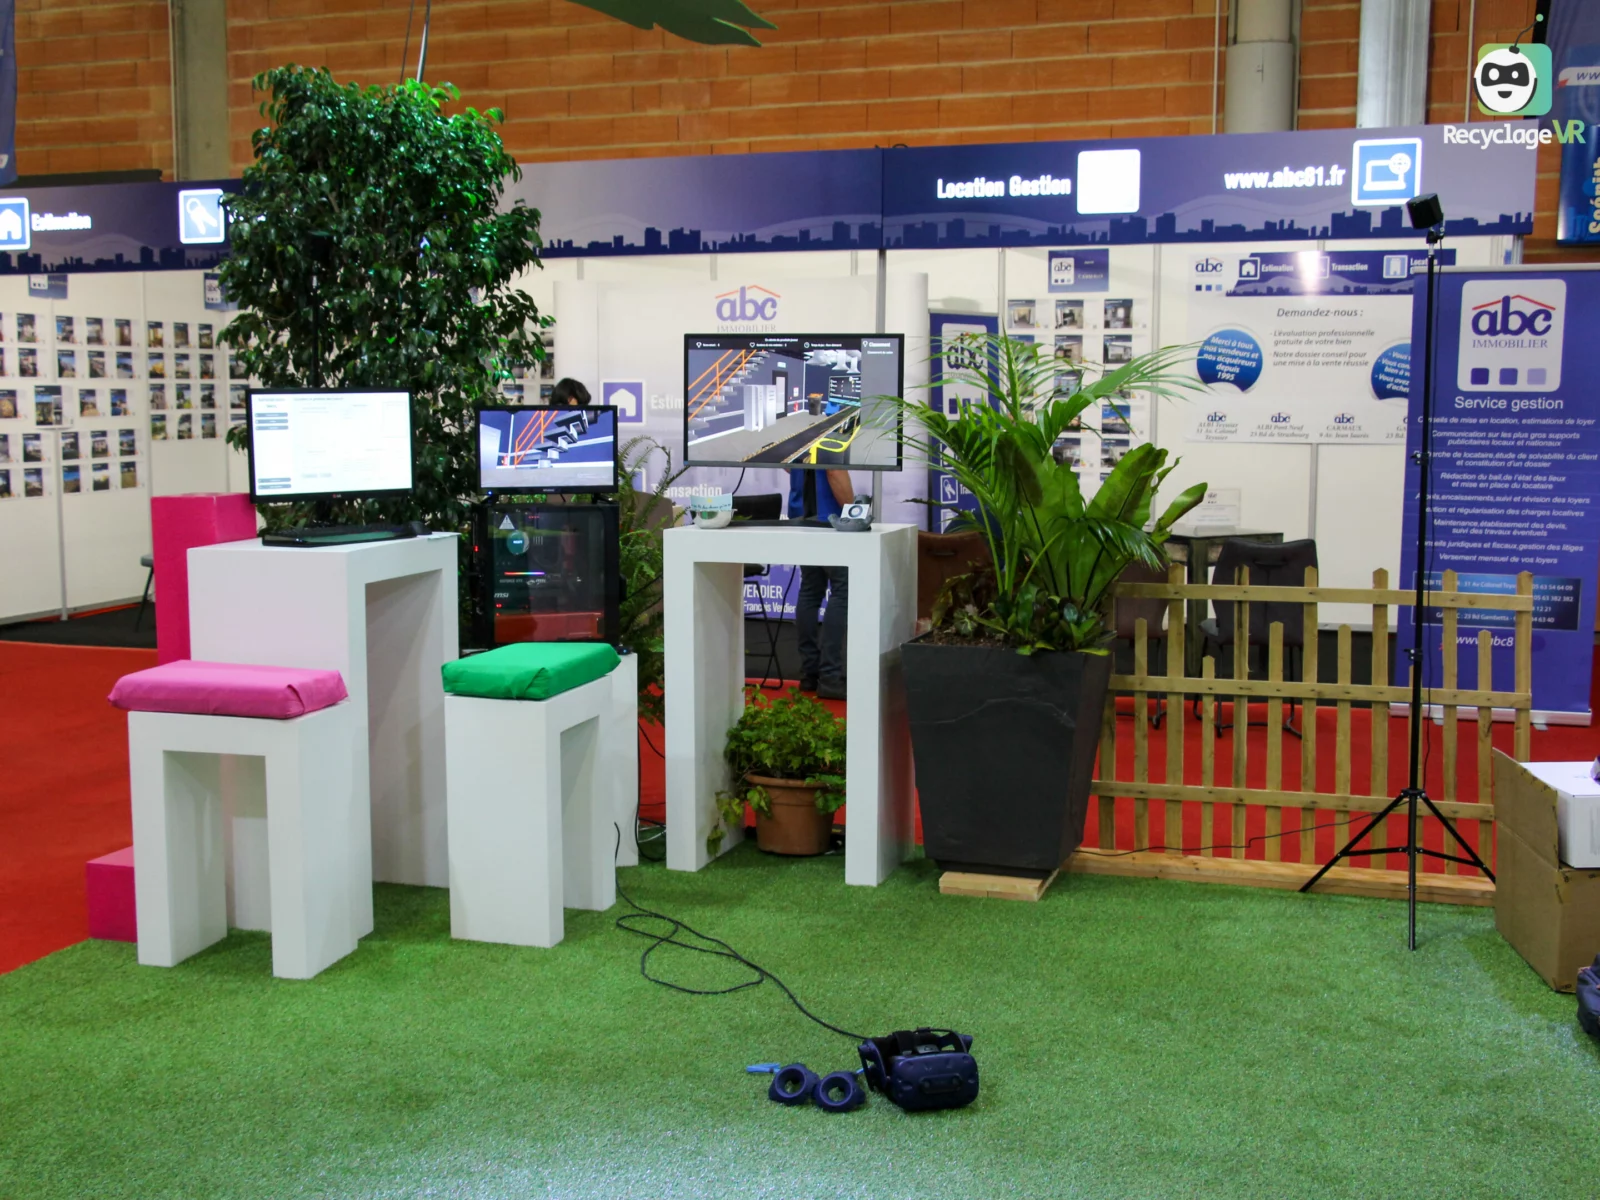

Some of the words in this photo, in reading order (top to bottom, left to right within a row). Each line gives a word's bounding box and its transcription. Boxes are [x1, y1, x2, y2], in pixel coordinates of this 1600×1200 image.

[1224, 164, 1347, 189] www.abc81.fr
[937, 178, 1004, 199] Location
[1009, 174, 1072, 196] Gestion
[1195, 257, 1223, 272] abc
[1261, 263, 1294, 273] Estimation
[1331, 262, 1369, 271] Transaction
[716, 286, 777, 321] abc
[1277, 308, 1358, 317] Demandez-nous
[1472, 295, 1552, 336] abc
[1318, 329, 1375, 338] professionnelle
[1211, 336, 1231, 345] Merci
[1238, 341, 1254, 350] tous
[1274, 338, 1303, 346] gratuite
[1472, 340, 1548, 349] IMMOBILIER
[1218, 348, 1250, 358] vendeurs
[1295, 350, 1321, 358] dossier
[1322, 350, 1348, 358] conseil
[1348, 352, 1367, 360] pour
[1382, 358, 1396, 367] Vous
[1216, 363, 1240, 374] depuis
[1384, 366, 1399, 375] bien
[1217, 372, 1235, 381] 1995
[1379, 374, 1394, 382] Vous
[1454, 396, 1507, 409] Service
[1511, 396, 1564, 412] gestion
[1207, 411, 1227, 422] abc
[1270, 412, 1291, 422] abc
[1334, 412, 1355, 423] abc
[1522, 417, 1563, 425] estimations
[1576, 418, 1595, 426] loyer
[1513, 431, 1529, 439] plus
[1548, 432, 1580, 440] supports
[1448, 438, 1490, 446] publicitaires
[1528, 452, 1564, 460] solvabilité
[1440, 472, 1476, 480] Rédaction
[1489, 482, 1509, 490] place
[1567, 497, 1590, 505] loyers
[1521, 509, 1551, 517] charges
[1552, 509, 1585, 517] locatives
[1512, 529, 1548, 537] éventuels
[1447, 541, 1482, 549] juridiques
[1562, 544, 1584, 552] litiges
[1439, 553, 1477, 561] Versement
[1535, 557, 1558, 565] loyers
